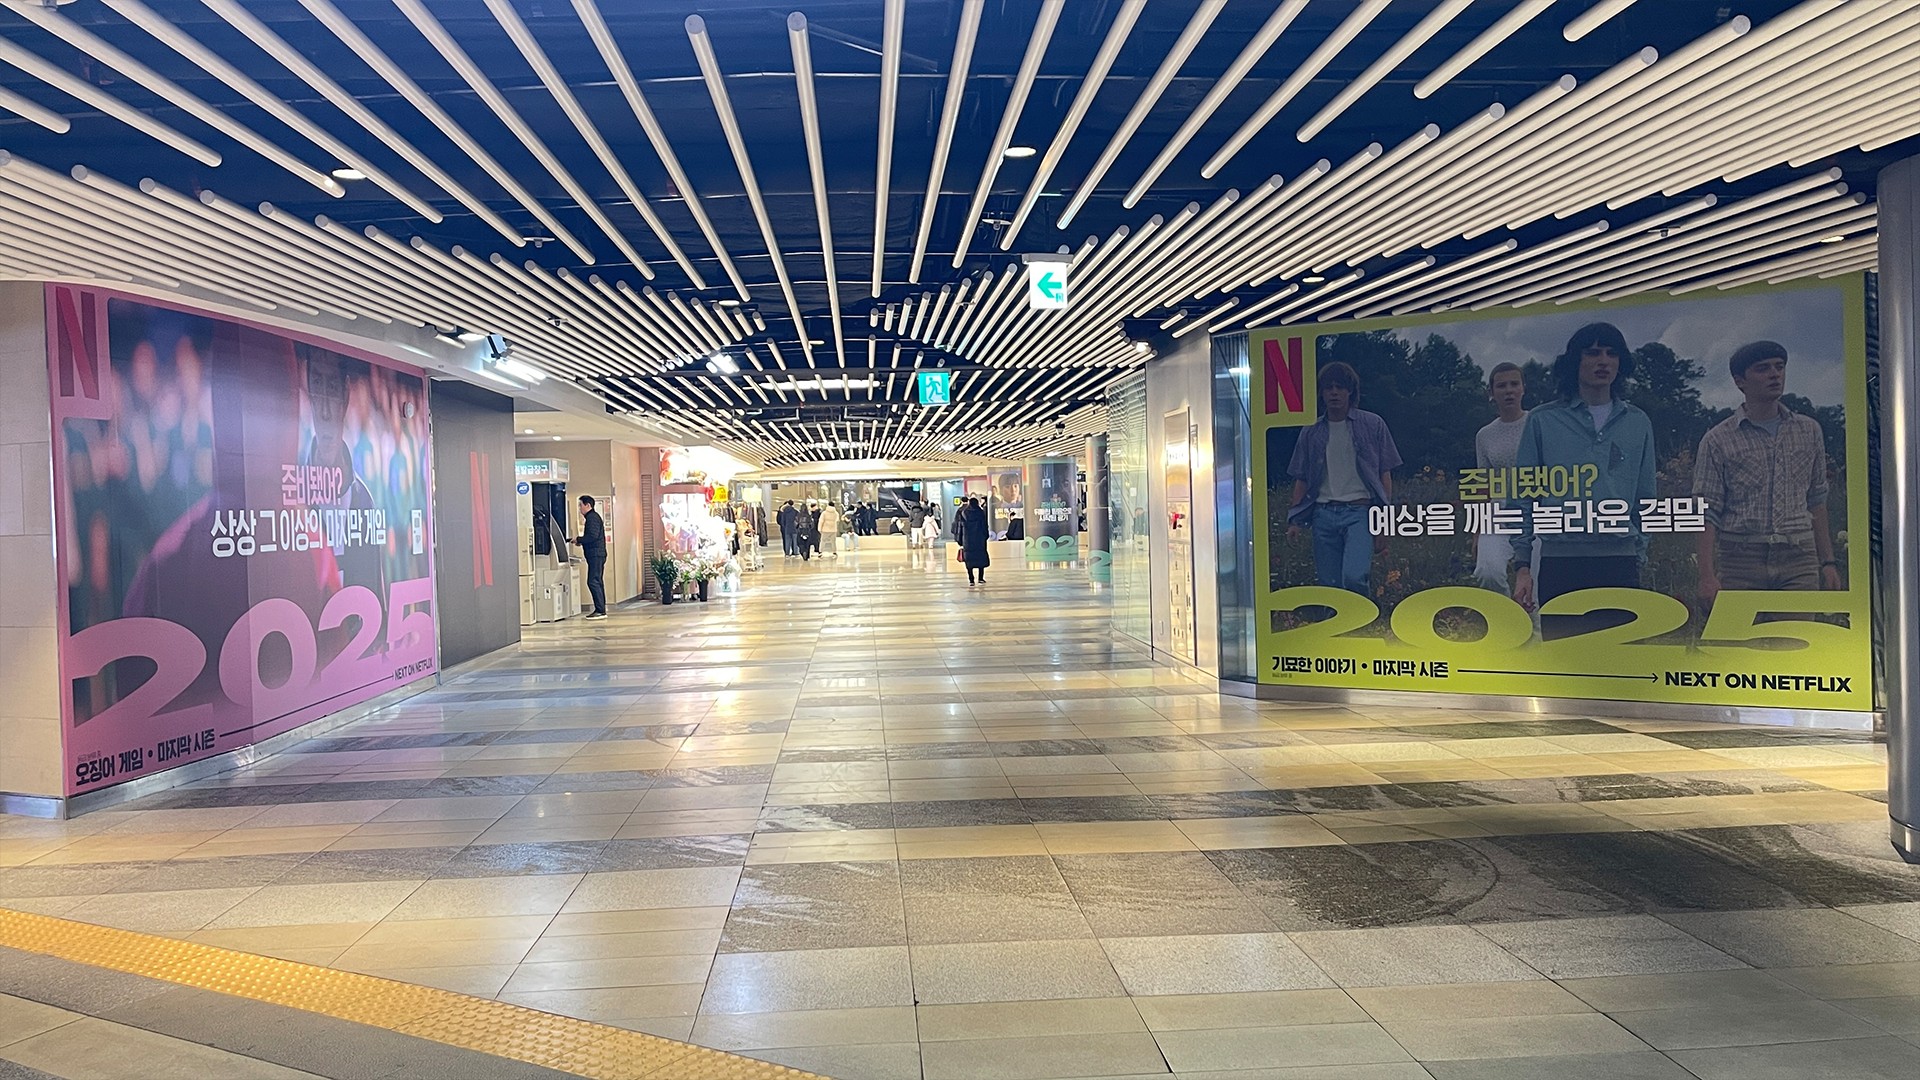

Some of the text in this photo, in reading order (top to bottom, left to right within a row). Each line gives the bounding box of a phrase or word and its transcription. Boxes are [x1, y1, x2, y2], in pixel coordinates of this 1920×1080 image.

[56, 286, 99, 400] N
[1263, 336, 1304, 415] N
[281, 464, 343, 506] 준비됐어?
[1458, 463, 1599, 500] 준비됐어?
[211, 509, 257, 558] 상상
[260, 510, 277, 552] 그
[280, 509, 323, 551] 이상의
[326, 509, 362, 547] 마지막
[364, 508, 386, 545] 게임
[1368, 497, 1710, 537] 예상을 깨는 놀라운 결말
[1025, 535, 1077, 551] 202
[1270, 586, 1852, 655] 2025
[70, 578, 433, 727] 2025
[394, 666, 408, 681] NEXT
[416, 656, 433, 672] NETFLIX
[1271, 656, 1449, 678] 기묘한 이야기 마지막 시즌
[1664, 671, 1852, 693] NEXT ON NETFLIX
[75, 755, 115, 787] 오징어
[118, 747, 144, 774] 게임
[157, 735, 192, 762] 마지막
[194, 728, 216, 752] 시즌
